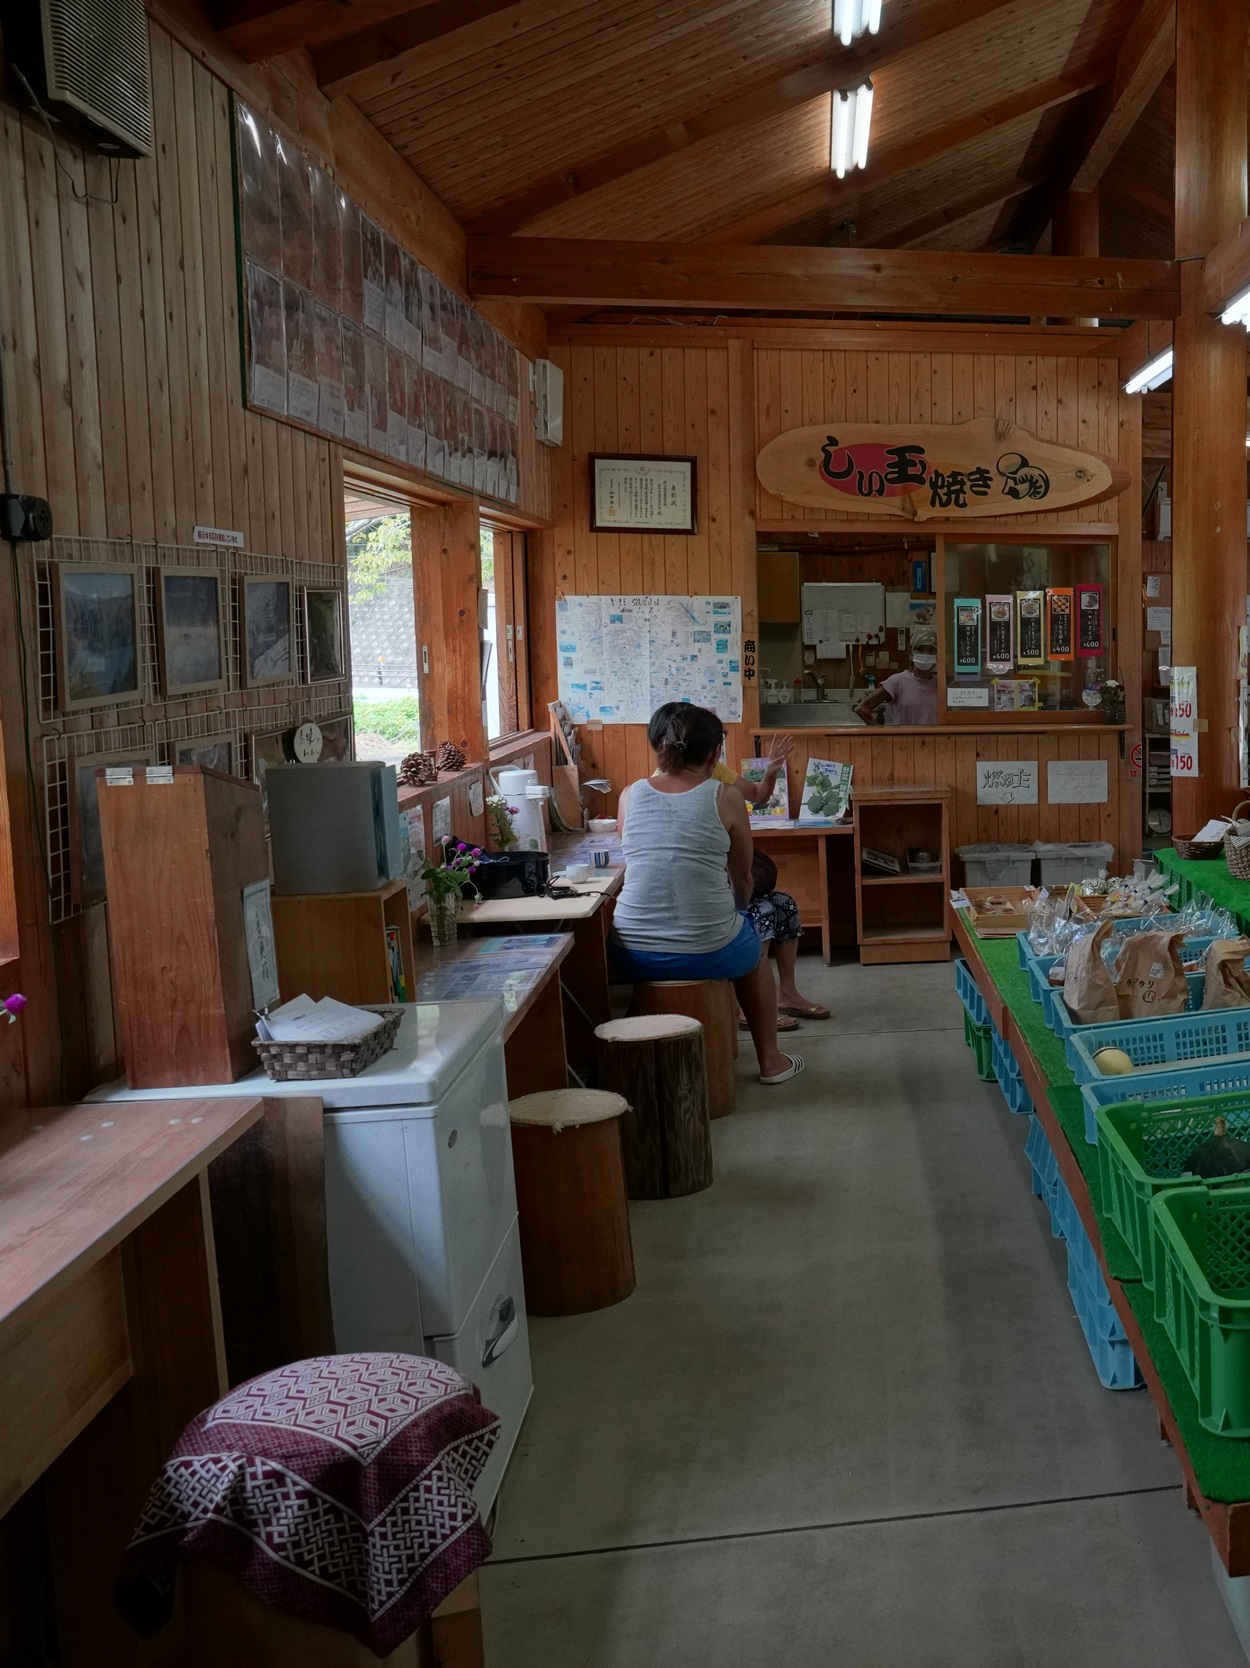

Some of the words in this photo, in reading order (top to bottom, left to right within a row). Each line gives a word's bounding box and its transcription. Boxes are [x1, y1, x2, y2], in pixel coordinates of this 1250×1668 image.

[822, 435, 993, 508] しい玉焼き
[744, 640, 756, 680] 商い中
